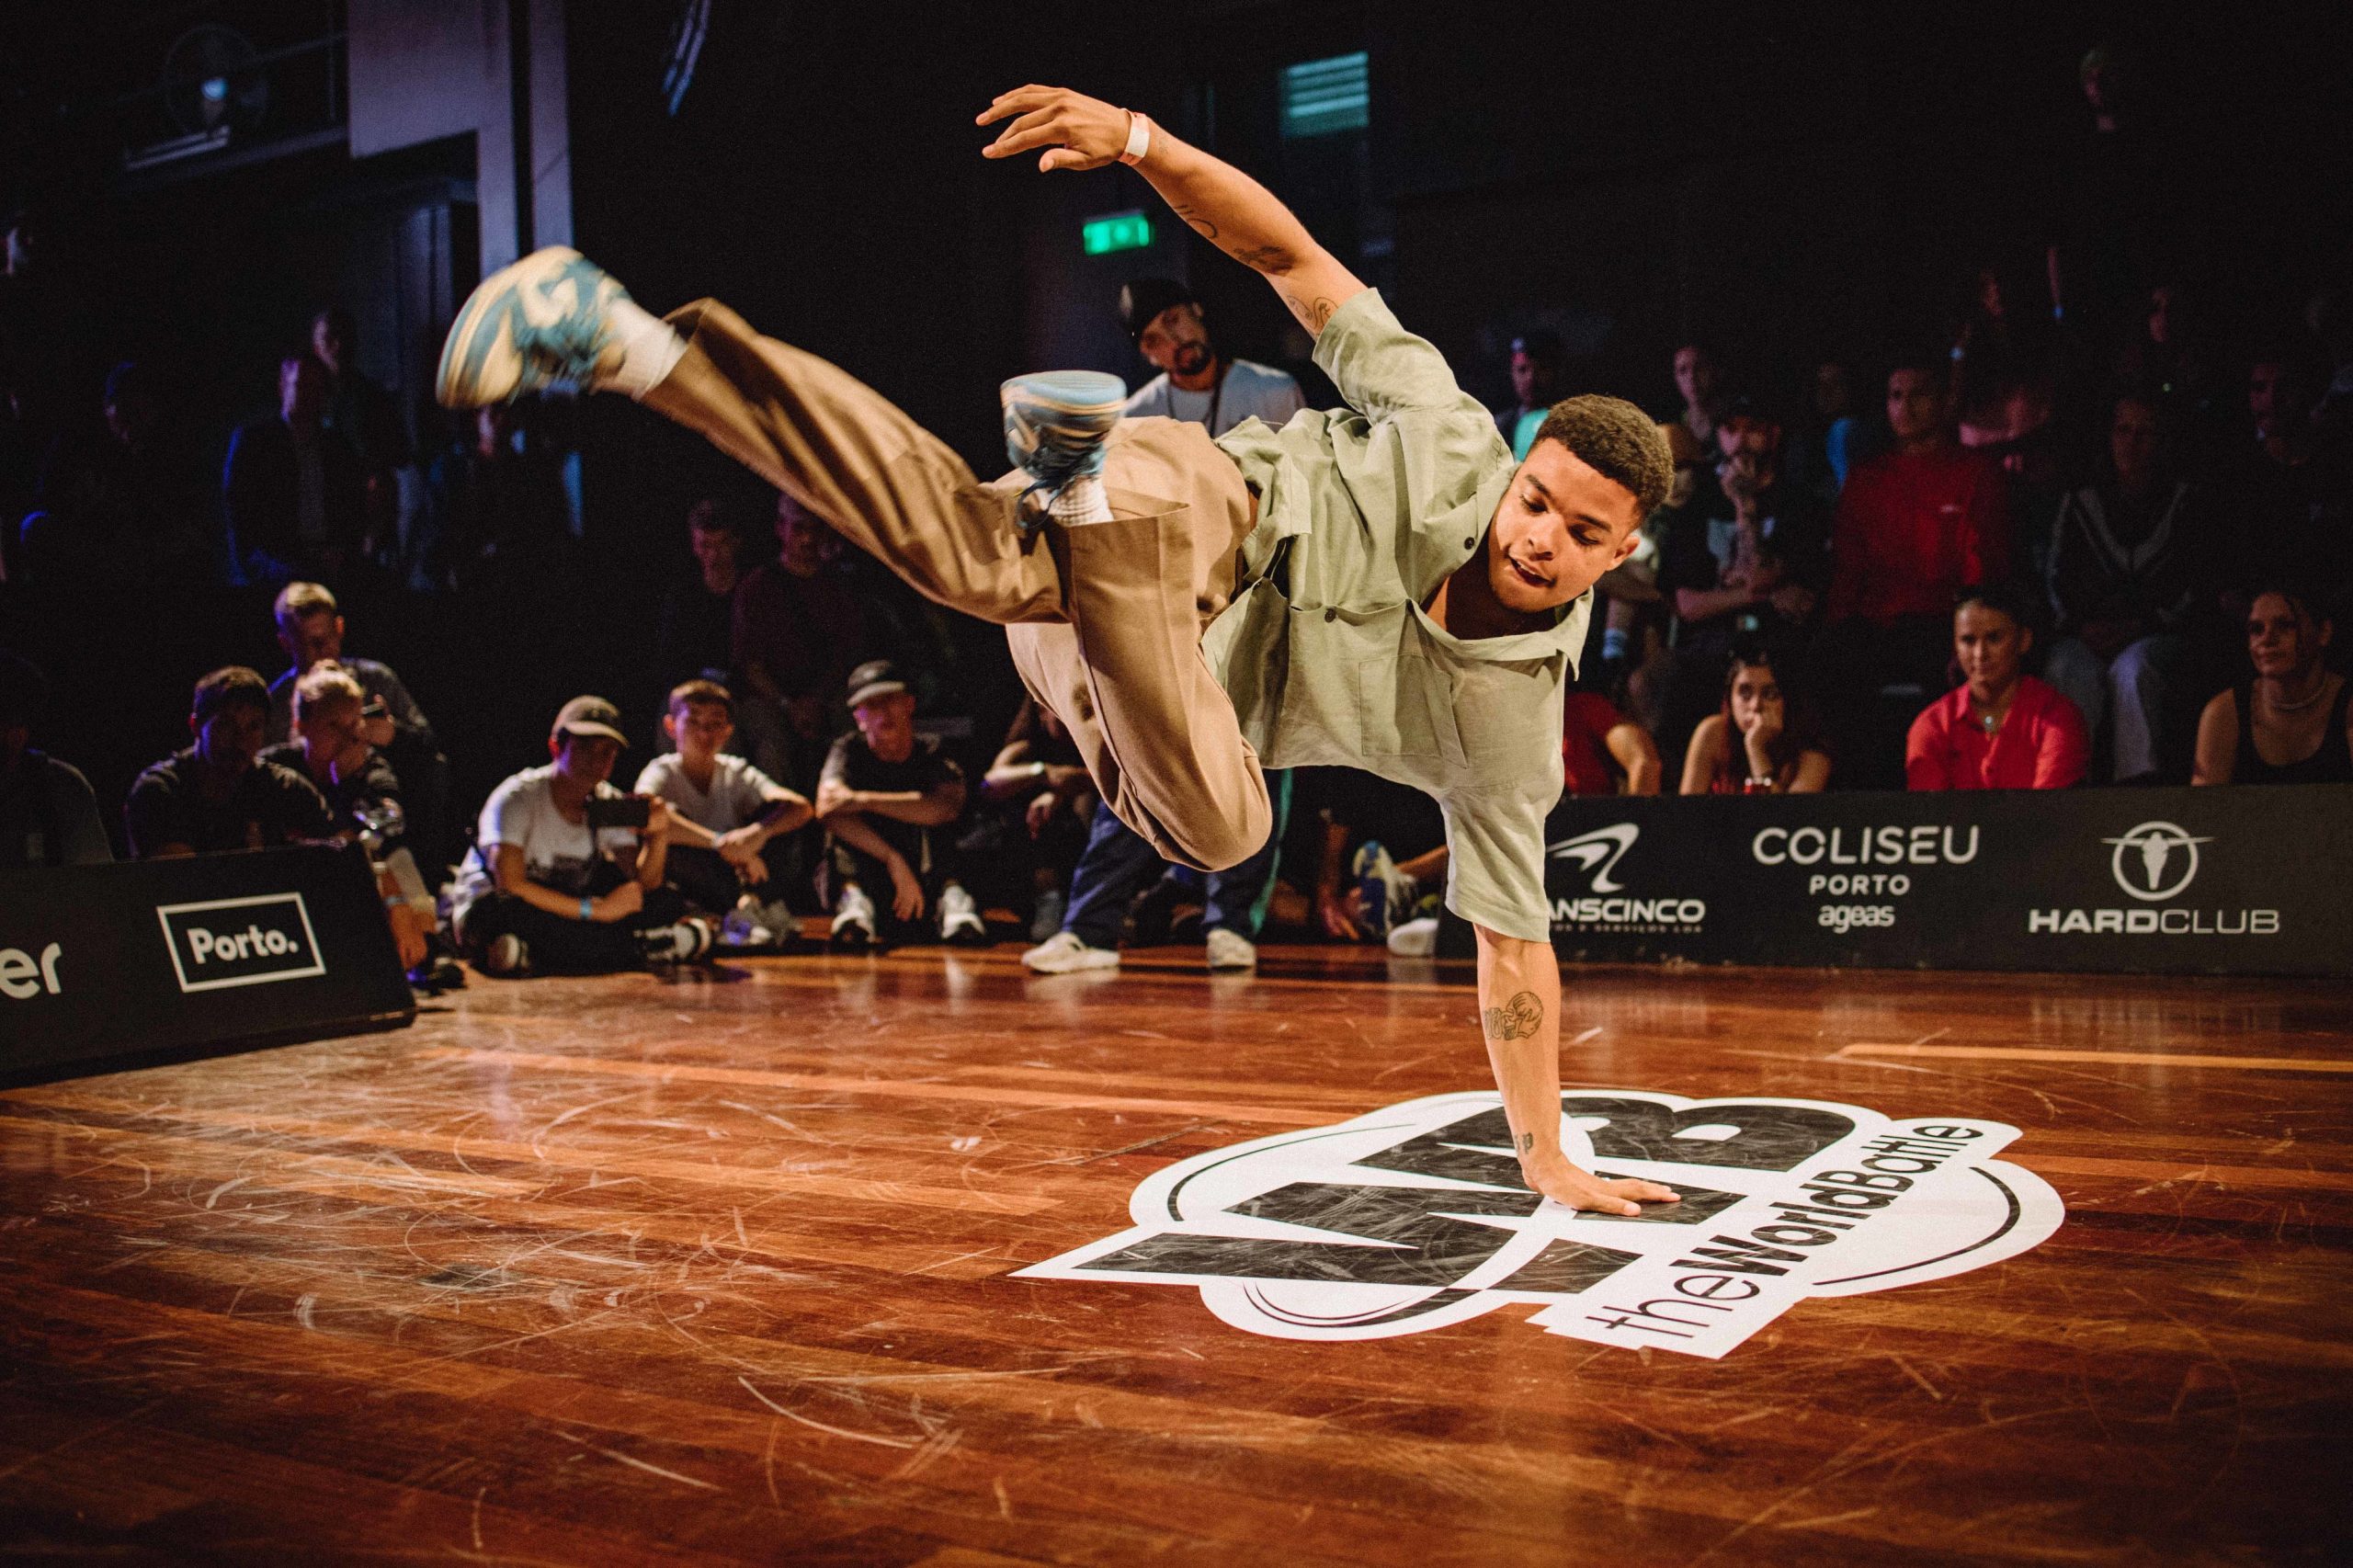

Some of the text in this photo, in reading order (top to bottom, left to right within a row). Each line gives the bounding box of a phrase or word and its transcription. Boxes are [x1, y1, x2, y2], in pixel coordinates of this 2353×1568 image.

[1752, 824, 1981, 865] COLISEU
[1809, 874, 1911, 896] PORTO
[1817, 904, 1895, 935] ageas
[2028, 908, 2280, 935] HARDCLUB
[187, 925, 299, 964] Porto.
